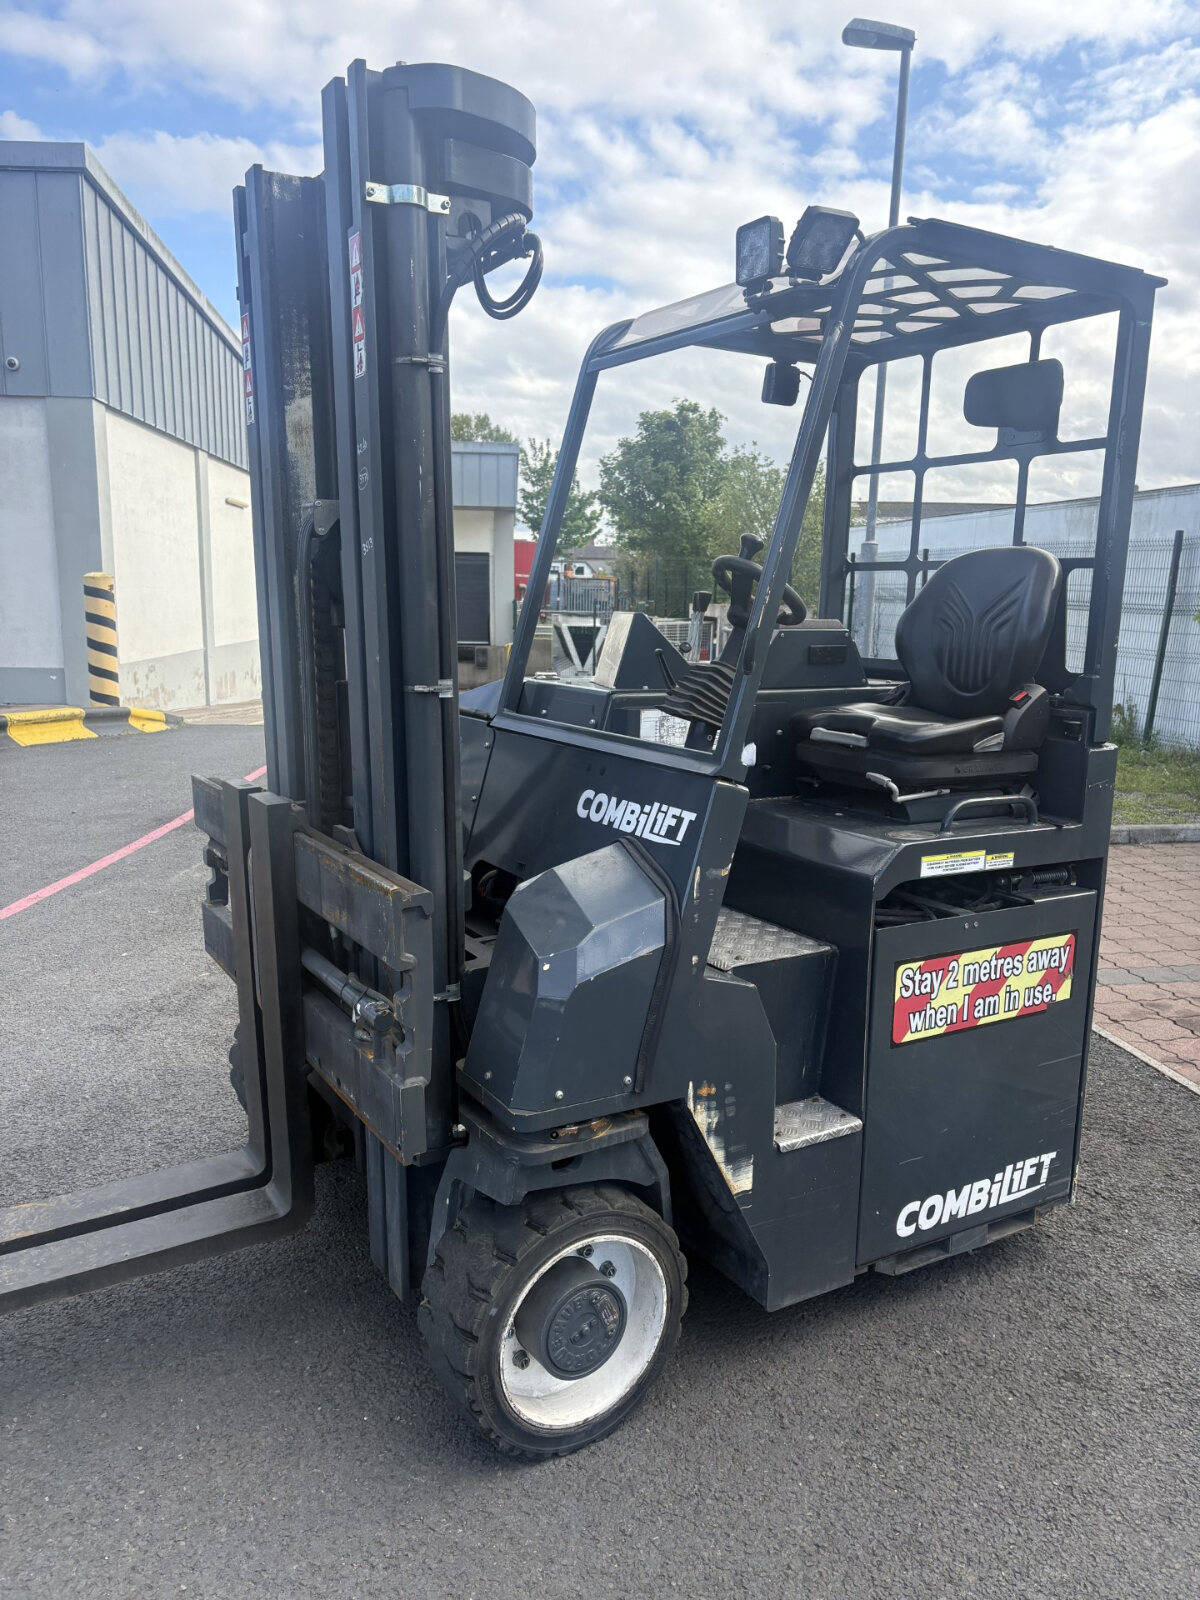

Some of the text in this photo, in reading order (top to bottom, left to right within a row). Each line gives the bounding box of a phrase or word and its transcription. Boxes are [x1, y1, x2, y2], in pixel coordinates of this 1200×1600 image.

[901, 944, 1071, 999] Stay 2 metres away
[909, 982, 1057, 1033] when I am in use.
